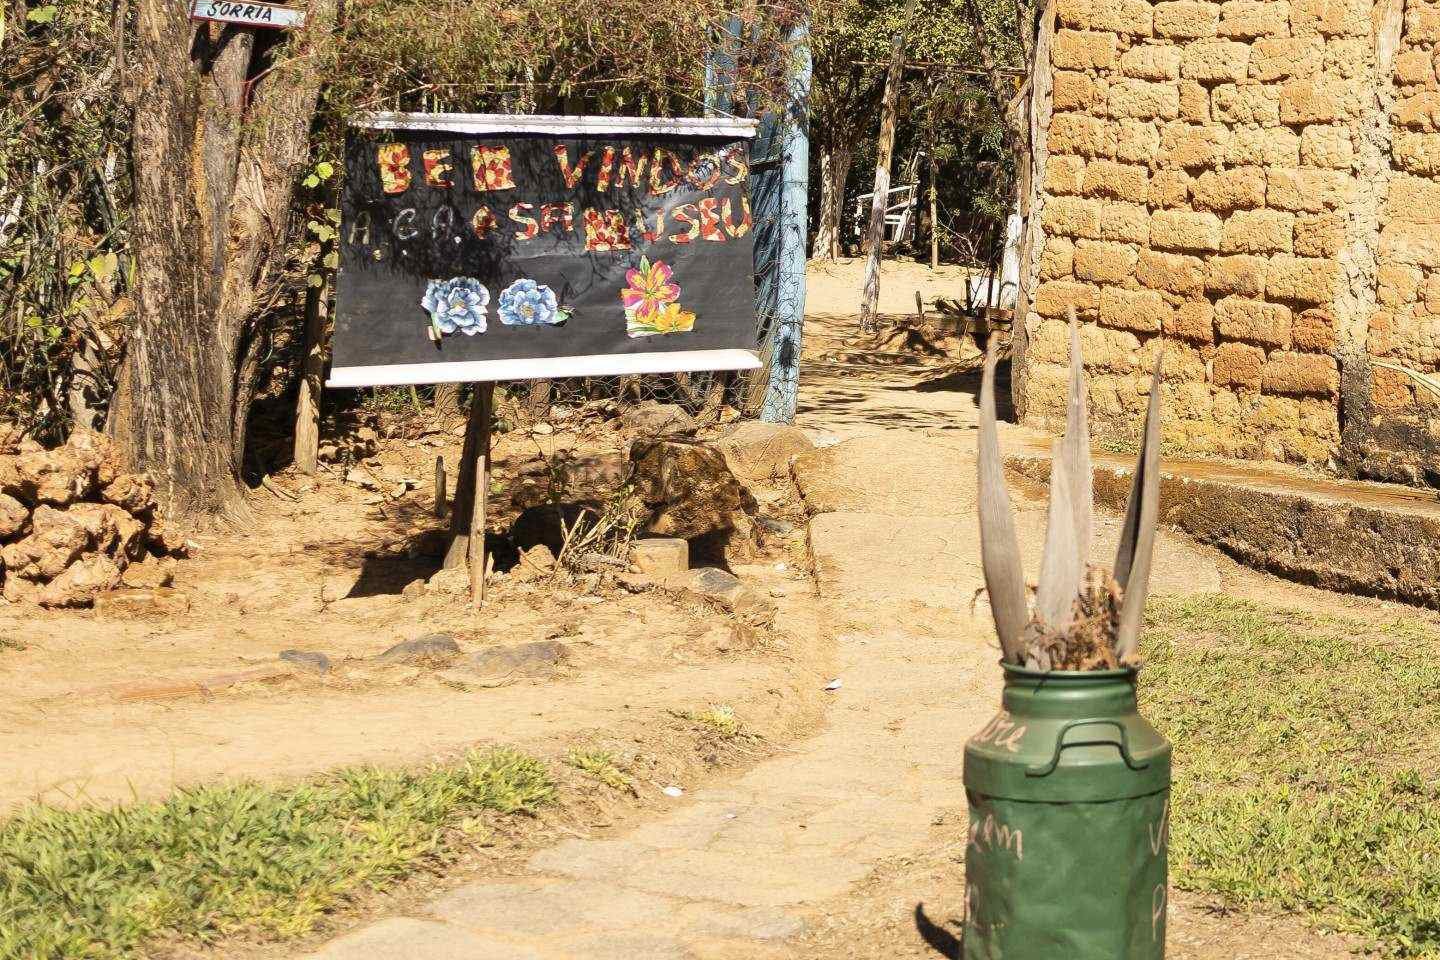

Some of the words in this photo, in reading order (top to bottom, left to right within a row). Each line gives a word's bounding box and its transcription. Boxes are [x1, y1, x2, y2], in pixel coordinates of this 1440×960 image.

[207, 1, 272, 22] SORRIA
[378, 143, 516, 193] BEM
[553, 142, 748, 195] VINDOS
[584, 195, 752, 251] MUSEU
